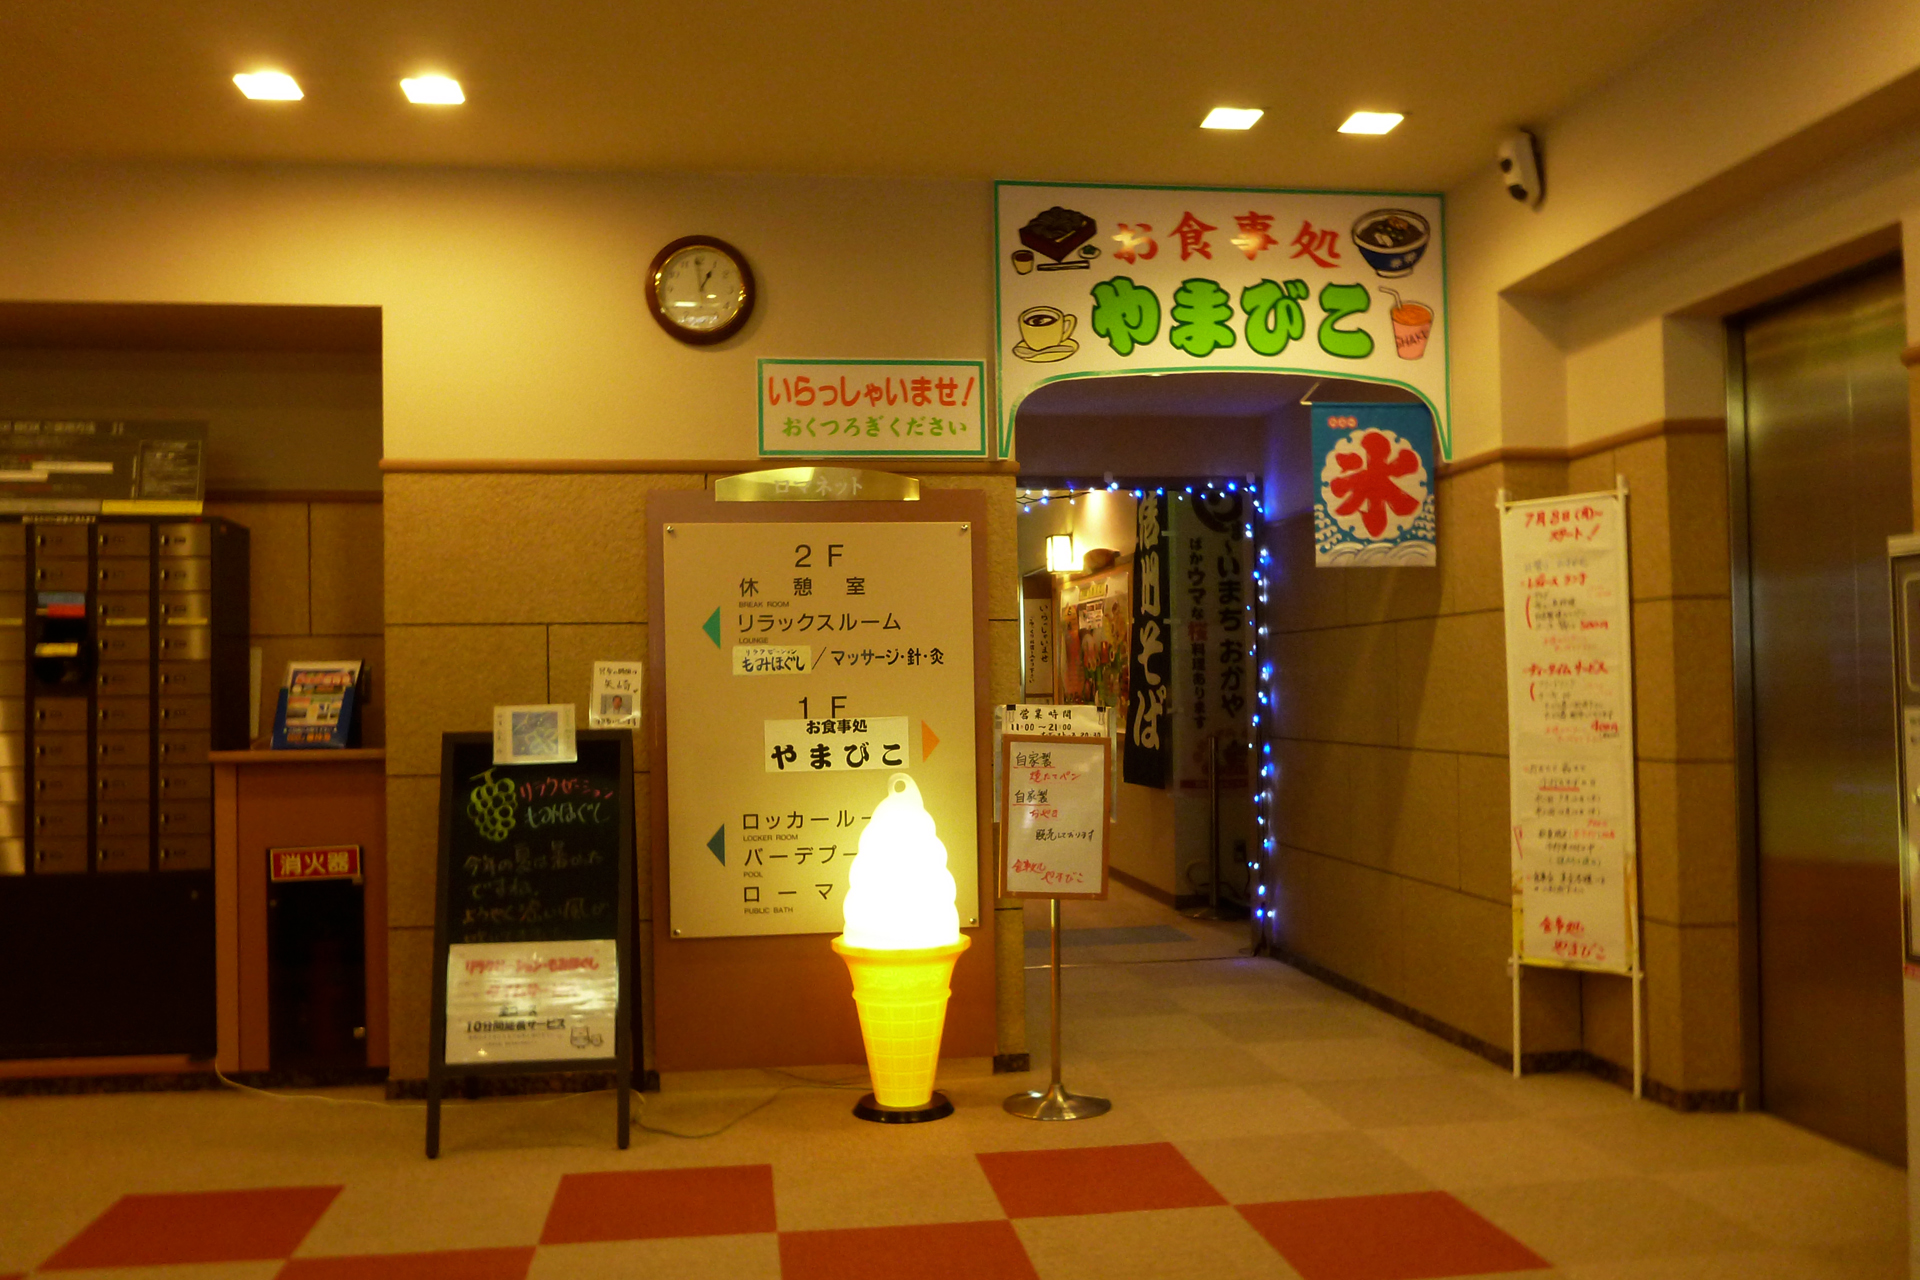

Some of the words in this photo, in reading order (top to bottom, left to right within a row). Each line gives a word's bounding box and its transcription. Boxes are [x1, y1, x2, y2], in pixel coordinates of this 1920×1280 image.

[1112, 211, 1342, 269] お食事処
[1091, 276, 1374, 359] やまびこ
[782, 415, 967, 437] おくつろぎください
[1330, 431, 1421, 538] 氷
[739, 577, 866, 597] 休憩室
[738, 612, 901, 633] リラックスルーム
[742, 655, 805, 672] もみほぐし
[1020, 709, 1072, 720] 営業時間
[806, 719, 868, 734] お食事処
[771, 741, 903, 770] やまびこ
[1015, 751, 1052, 767] 自家製
[1014, 789, 1049, 804] 自家製
[280, 851, 349, 876] 消火器
